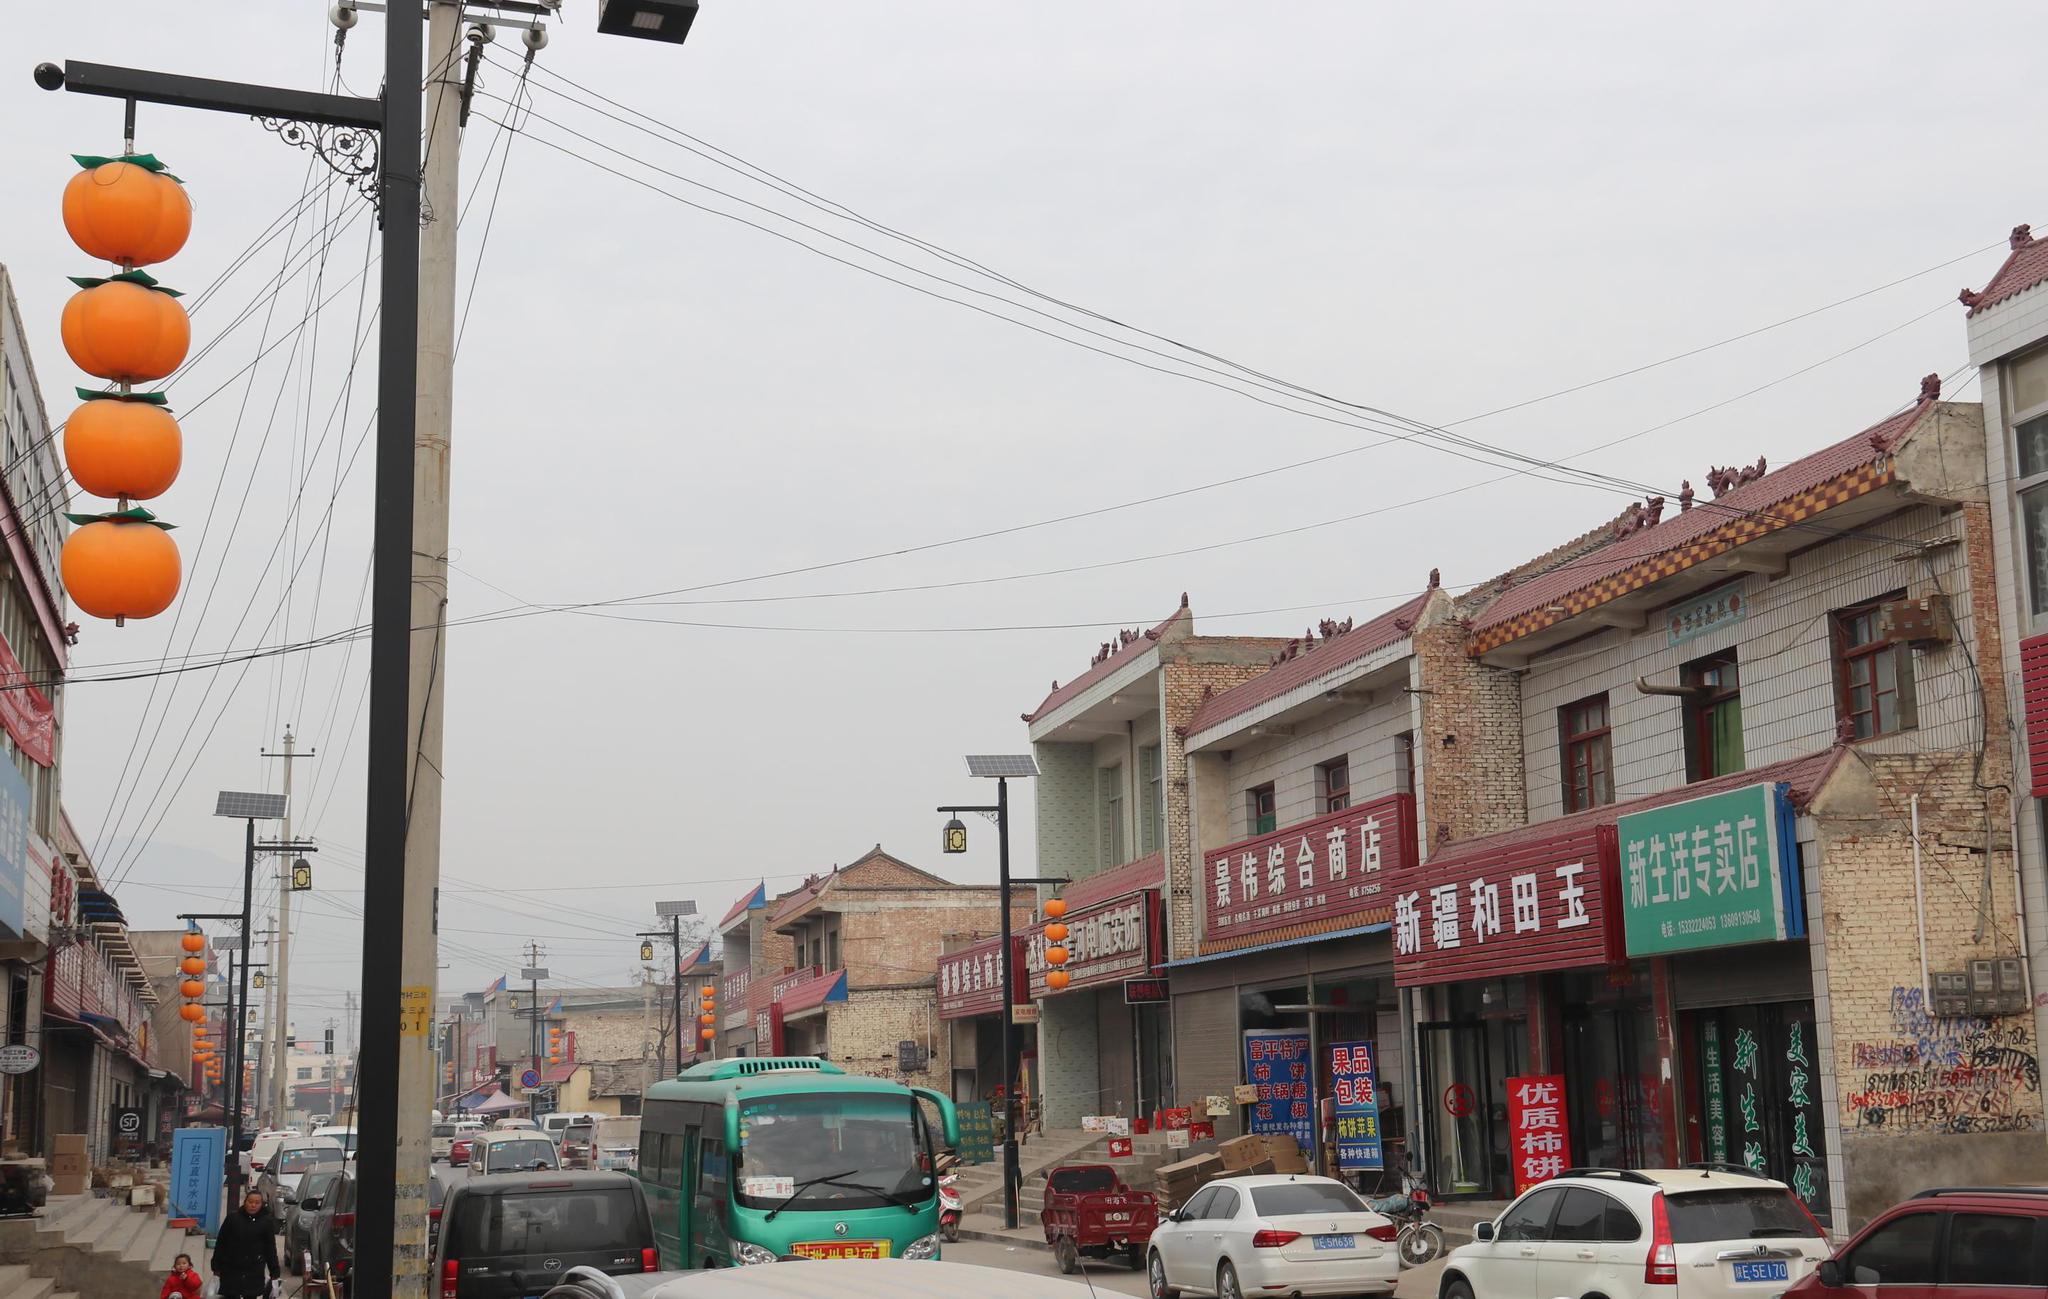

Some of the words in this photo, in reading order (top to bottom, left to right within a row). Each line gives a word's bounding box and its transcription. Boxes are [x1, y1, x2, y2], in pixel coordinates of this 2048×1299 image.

[1215, 816, 1382, 907] 景伟综合商店
[1628, 814, 1760, 909] 新生活专卖店
[1395, 862, 1590, 955] 新疆和田玉
[1250, 1039, 1309, 1060] 富平特产
[1332, 1046, 1371, 1076] 果品
[1335, 1077, 1373, 1106] 包装
[1337, 1116, 1377, 1140] 柿饼苹果
[1515, 1082, 1565, 1180] 优质柿饼
[1786, 1020, 1817, 1203] 美容美体
